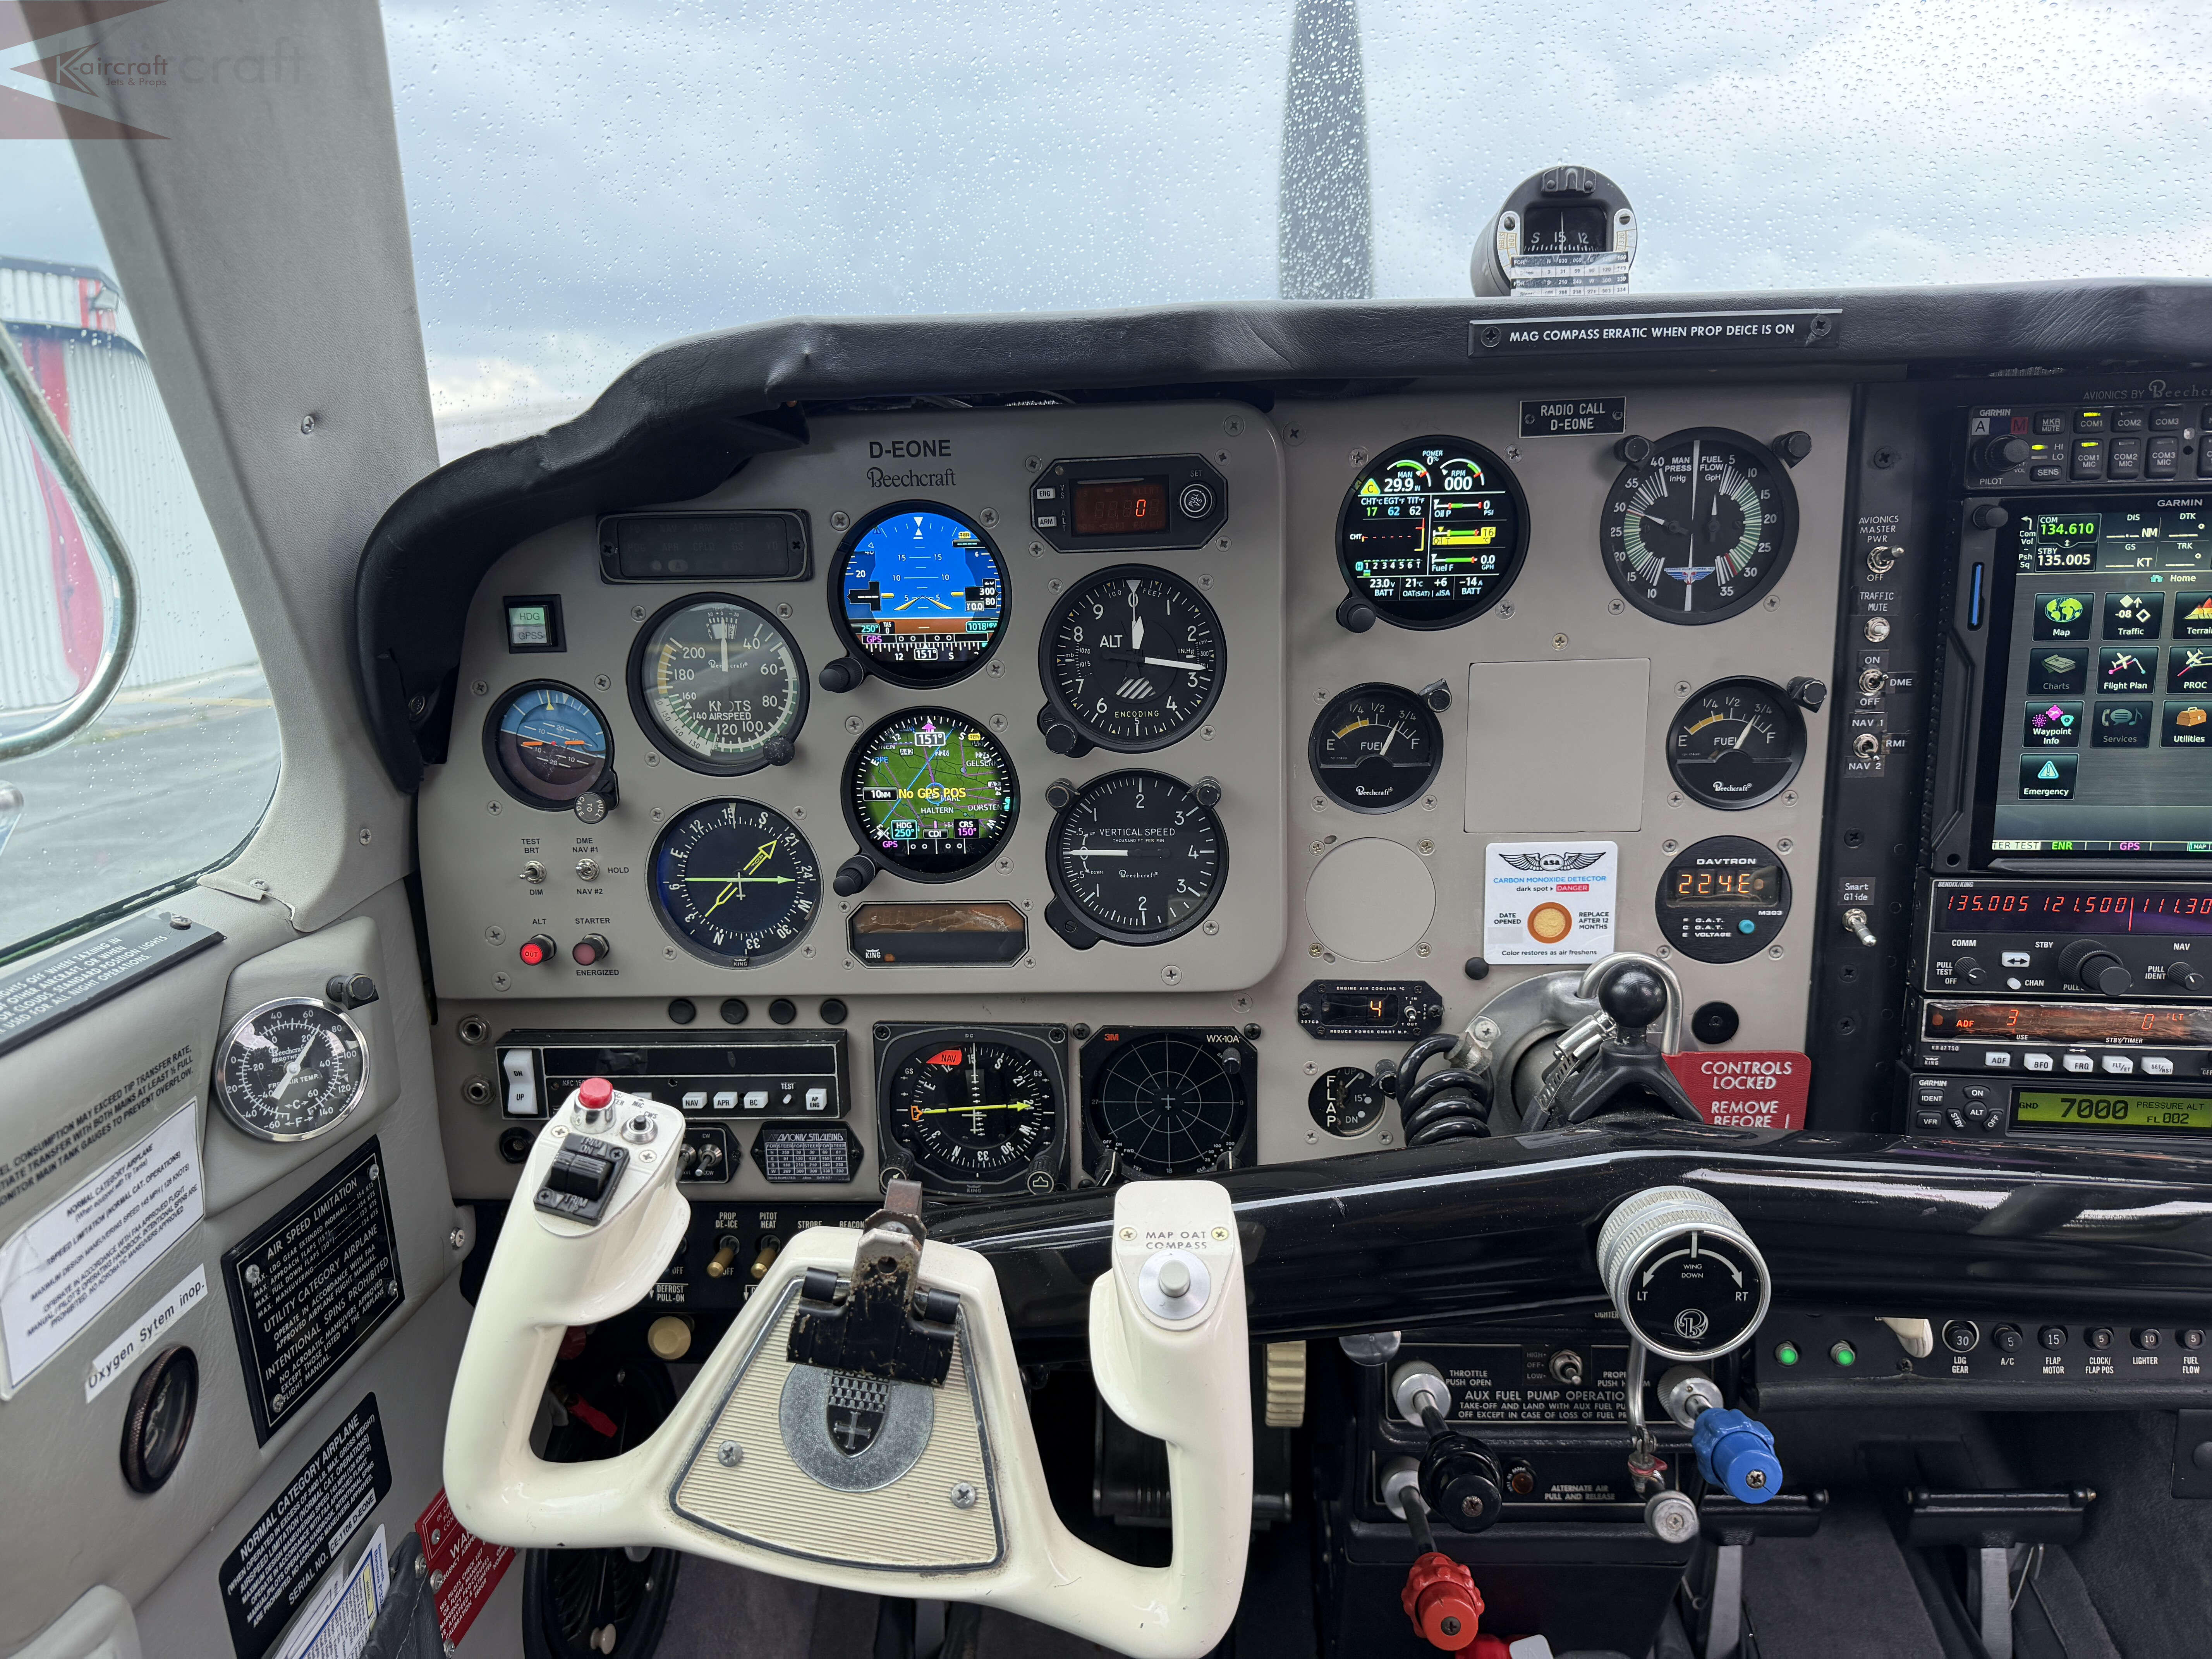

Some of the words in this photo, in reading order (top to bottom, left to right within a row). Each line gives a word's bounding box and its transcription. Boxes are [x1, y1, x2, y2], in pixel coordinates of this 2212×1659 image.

[1531, 232, 1540, 243] S
[1554, 232, 1566, 243] 15
[1578, 233, 1589, 244] 12
[1510, 330, 1539, 342] MAG
[1543, 328, 1599, 341] COMPASS
[1603, 326, 1647, 339] ERRATIC
[1651, 326, 1686, 337] WHEN
[1691, 325, 1722, 336] PROP
[1726, 324, 1757, 335] DEICE
[1762, 324, 1771, 334] IS
[1775, 324, 1794, 334] ON
[1540, 403, 1574, 416] RADIO
[1579, 403, 1605, 414] CALL
[1551, 418, 1594, 430] D-EONE
[869, 439, 951, 458] D-EONE
[867, 467, 957, 488] Beechcraft
[1384, 478, 1414, 492] 29.9
[1444, 478, 1472, 490] 000
[1859, 515, 1899, 524] AVIONICS
[1860, 525, 1896, 533] MASTER
[2041, 523, 2094, 535] 134.610
[2038, 554, 2090, 566] 135.005
[1143, 588, 1162, 598] FEET
[1860, 592, 1894, 601] TRAFFIC
[1868, 603, 1887, 611] MUTE
[519, 612, 540, 621] HDG
[519, 632, 543, 640] GPSS
[866, 635, 883, 643] GPS
[1100, 635, 1123, 647] ALT
[674, 669, 694, 680] 180
[2104, 682, 2127, 690] Flight
[763, 696, 777, 707] 80
[709, 711, 751, 721] AIRSPEED
[2033, 728, 2071, 736] Waypoint
[898, 789, 914, 799] No
[917, 788, 940, 799] GPS
[943, 787, 966, 798] POS
[2023, 788, 2069, 797] Emergency
[968, 803, 1002, 811] DORSTEN
[2052, 842, 2073, 850] ENR
[1533, 885, 1548, 893] spot
[1206, 1034, 1239, 1043] WX-10A
[1701, 1061, 1792, 1075] CONTROLS
[1713, 1076, 1776, 1089] LOCKED
[1711, 1101, 1779, 1114] REMOVE
[2061, 1098, 2129, 1120] 7000
[267, 1240, 283, 1260] AIR
[286, 1218, 310, 1243] SPEED
[313, 1177, 357, 1221] LIMITATION
[716, 1220, 738, 1228] DE-ICE
[761, 1220, 776, 1228] HEAT
[264, 1298, 296, 1332] UTILITY
[298, 1258, 340, 1302] CATEGORY
[344, 1224, 378, 1262] AIRPLANE
[140, 1302, 174, 1341] Sytem
[179, 1282, 205, 1308] inop.
[1465, 1391, 1490, 1400] AUX
[1496, 1391, 1521, 1400] FUEL
[1527, 1391, 1560, 1400] PUMP
[240, 1514, 277, 1561] NORMAL
[277, 1462, 321, 1515] CATEGORY
[323, 1414, 359, 1464] AIRPLANE
